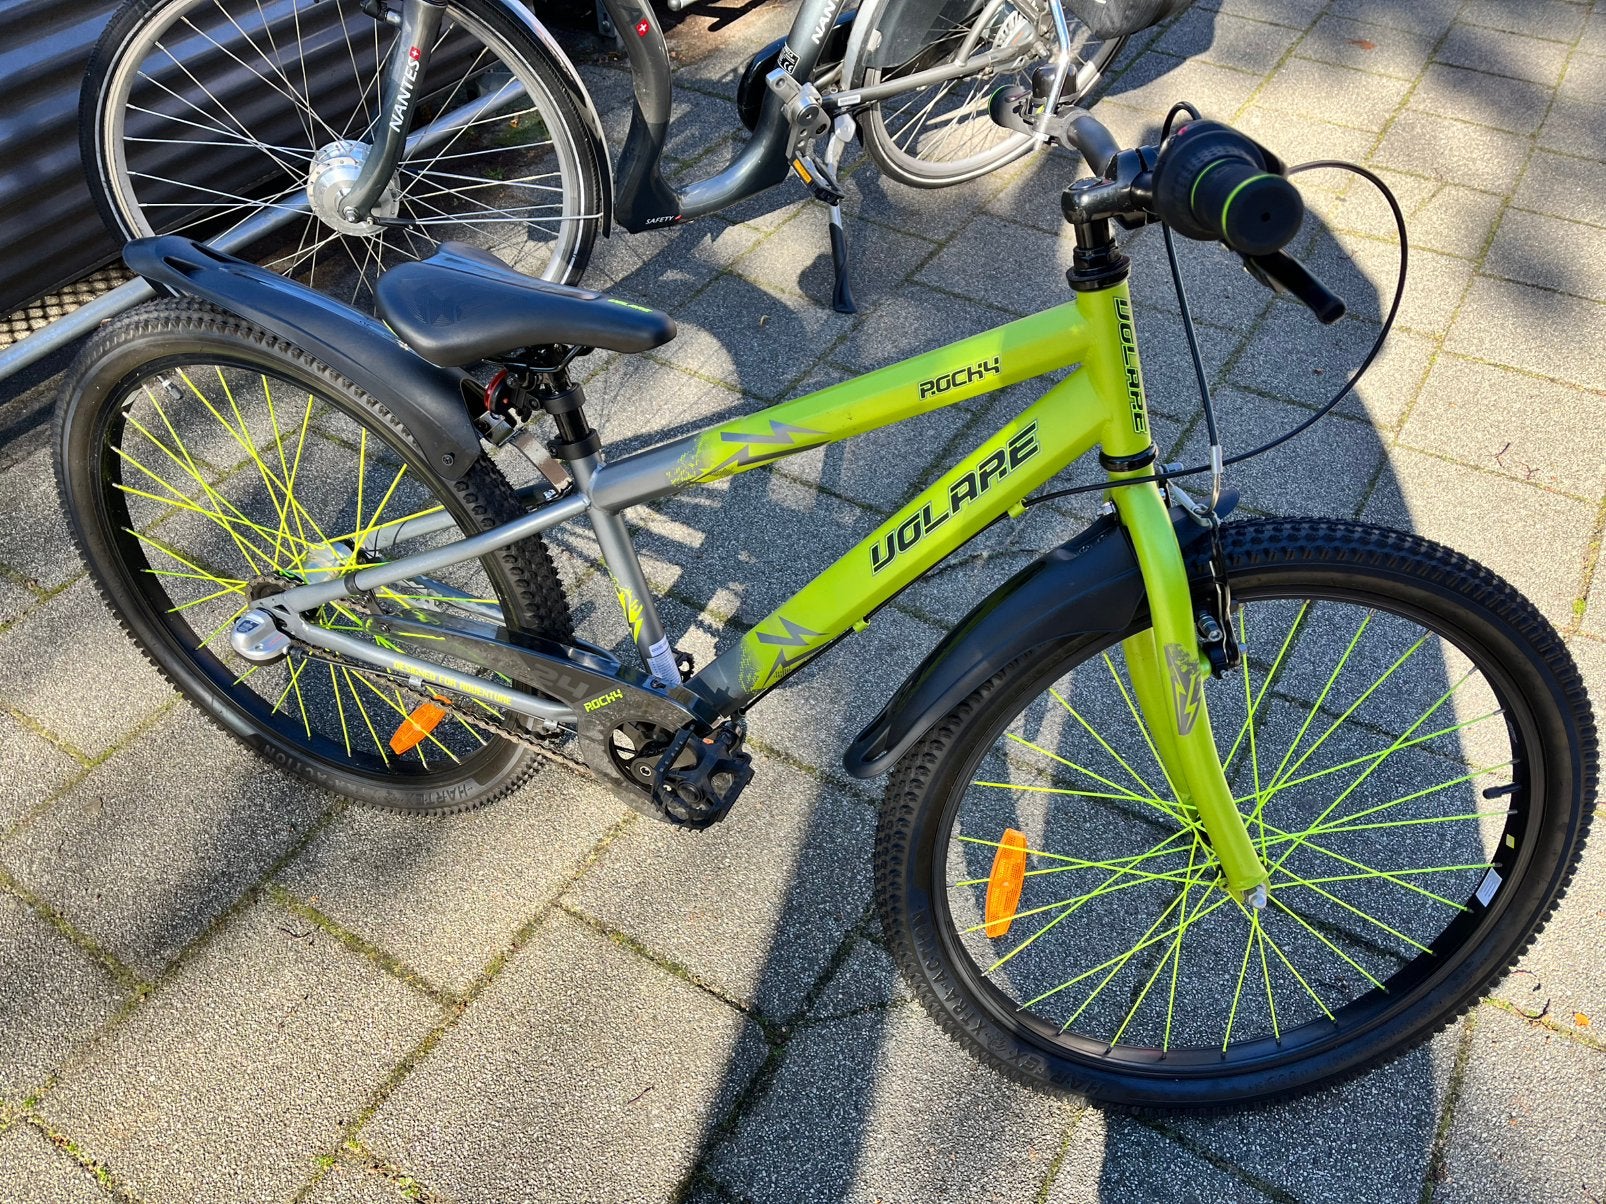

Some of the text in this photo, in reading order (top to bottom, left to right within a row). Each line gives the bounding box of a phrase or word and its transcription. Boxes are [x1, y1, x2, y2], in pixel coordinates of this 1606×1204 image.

[389, 57, 420, 133] NANTES
[645, 215, 675, 225] SAFETY
[918, 356, 1000, 400] ROCKY
[393, 660, 512, 706] DESIGNED FOR ADVENTURE
[533, 663, 590, 699] 24
[583, 688, 624, 713] ROCKY
